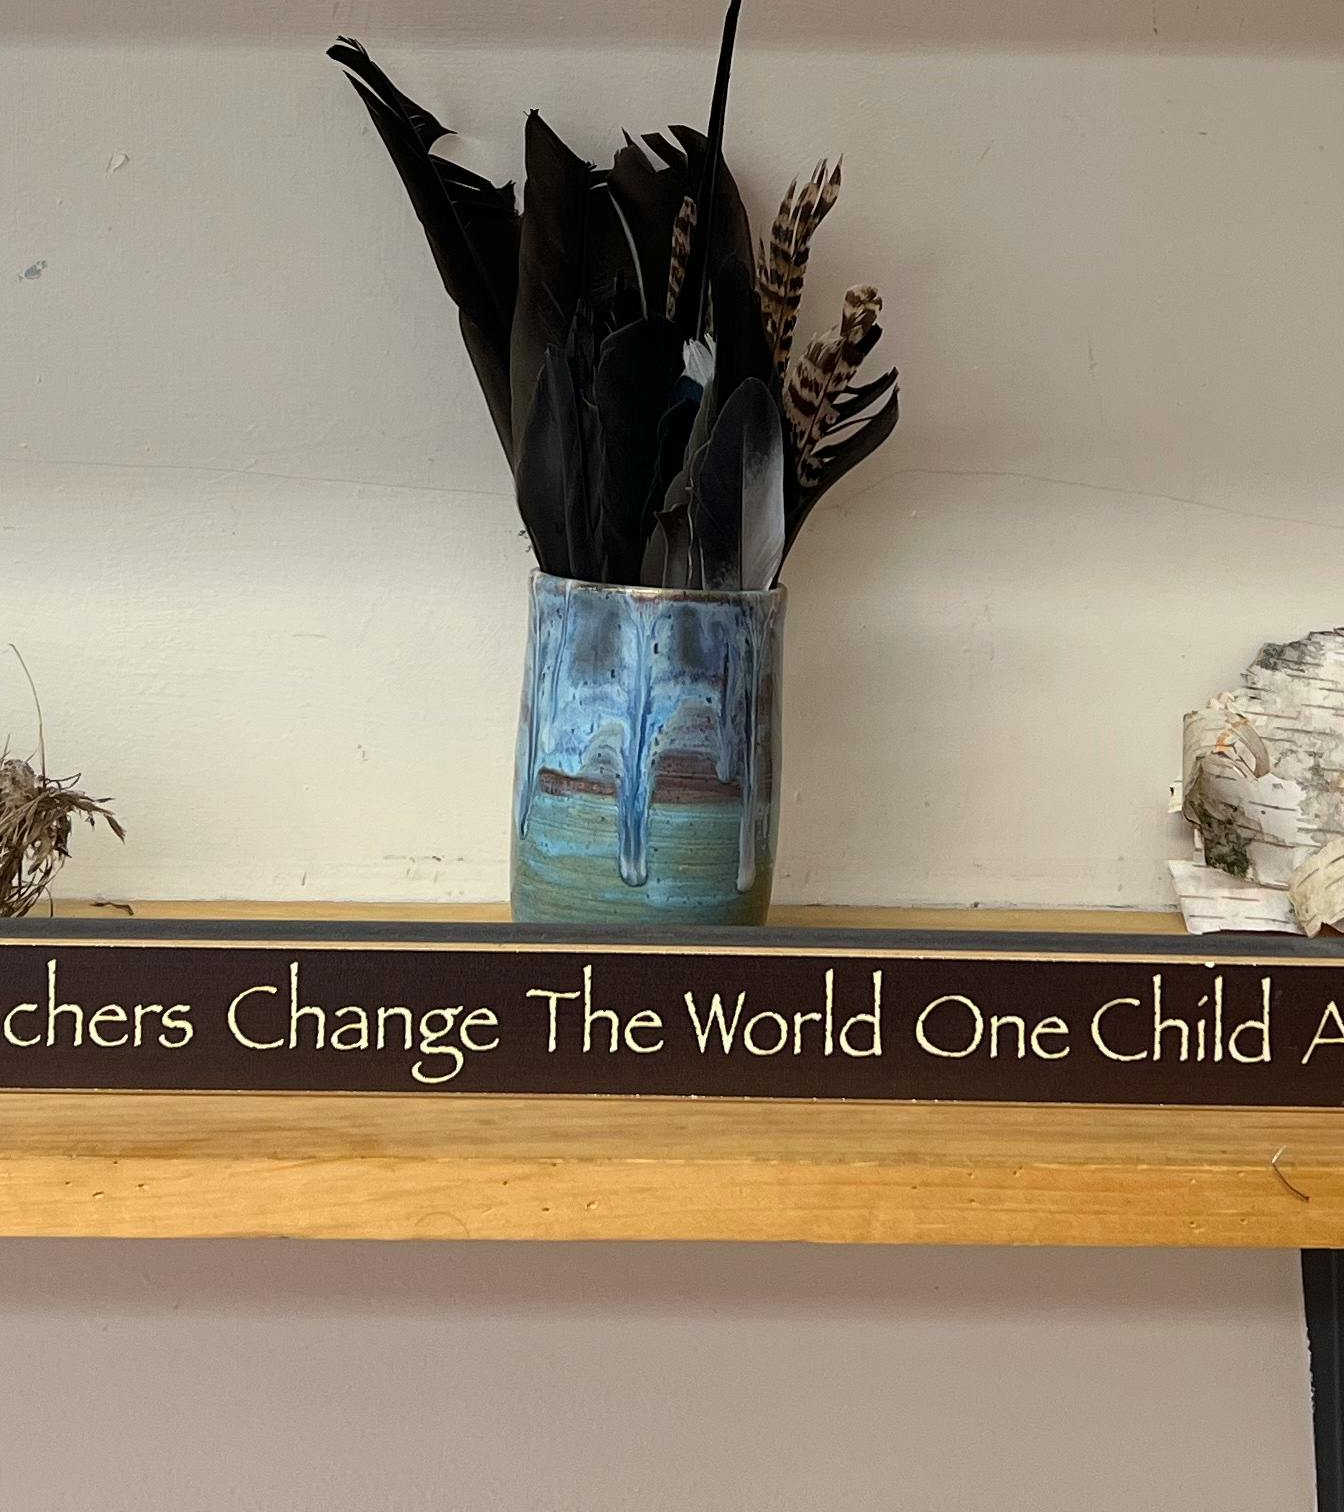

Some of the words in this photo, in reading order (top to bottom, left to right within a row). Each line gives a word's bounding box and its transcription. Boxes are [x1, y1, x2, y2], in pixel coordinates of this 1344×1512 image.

[227, 961, 500, 1084] Change
[525, 964, 664, 1053] The
[683, 968, 883, 1057] World
[915, 995, 1070, 1059] One
[1090, 973, 1272, 1063] Child
